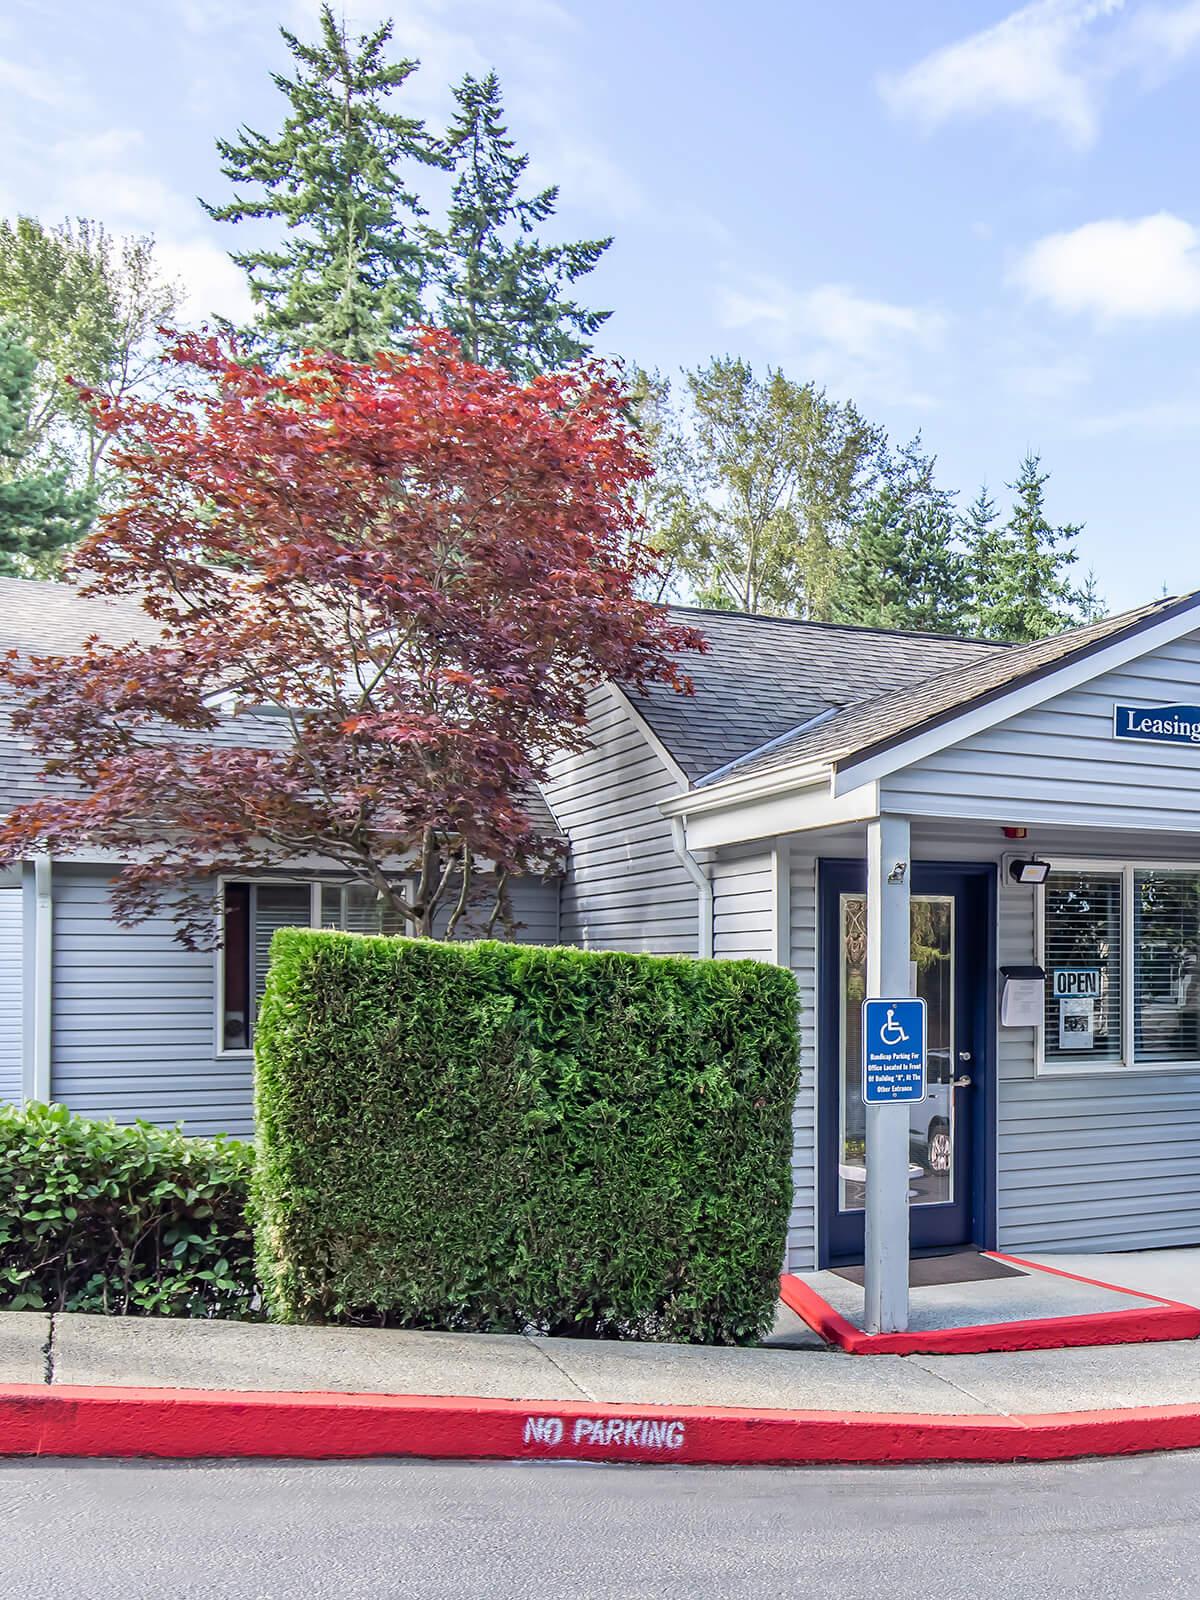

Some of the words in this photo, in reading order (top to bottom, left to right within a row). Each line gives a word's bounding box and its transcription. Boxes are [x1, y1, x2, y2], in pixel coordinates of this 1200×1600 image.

[1057, 972, 1096, 994] OPEN
[870, 1053, 891, 1061] Handicap
[893, 1053, 911, 1061] Parking
[523, 1417, 563, 1446] NO
[574, 1418, 686, 1449] PARKING
